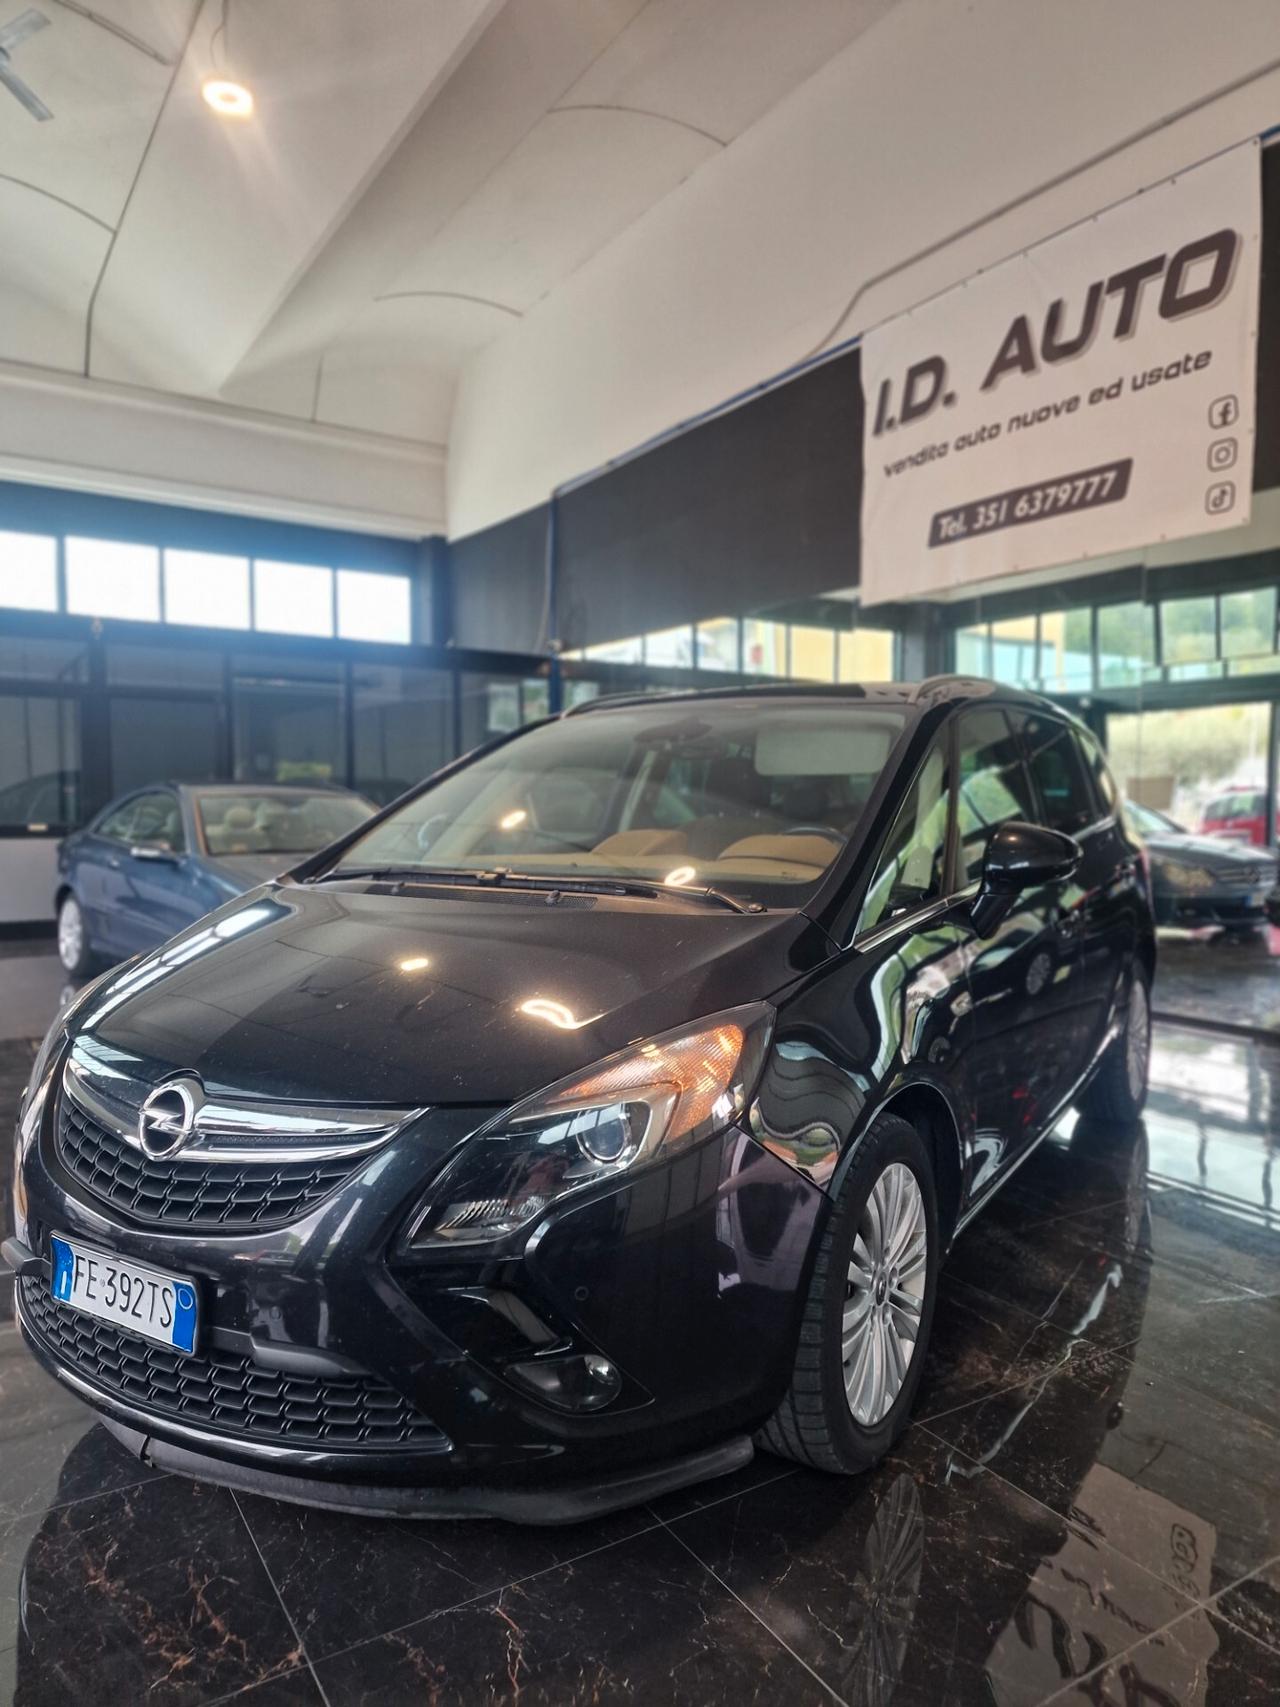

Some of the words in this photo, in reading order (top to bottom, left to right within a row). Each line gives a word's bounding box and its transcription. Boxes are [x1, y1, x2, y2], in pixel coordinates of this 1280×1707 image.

[872, 355, 956, 438] I.D.
[979, 228, 1240, 392] AUTO
[884, 441, 949, 478] vendita
[953, 422, 1001, 452] auto
[1007, 395, 1080, 433] nuove
[1088, 376, 1123, 405] ed
[1131, 350, 1212, 391] usate
[938, 510, 968, 540] Tel.
[973, 498, 1008, 530] 351
[1014, 470, 1118, 519] 6379777
